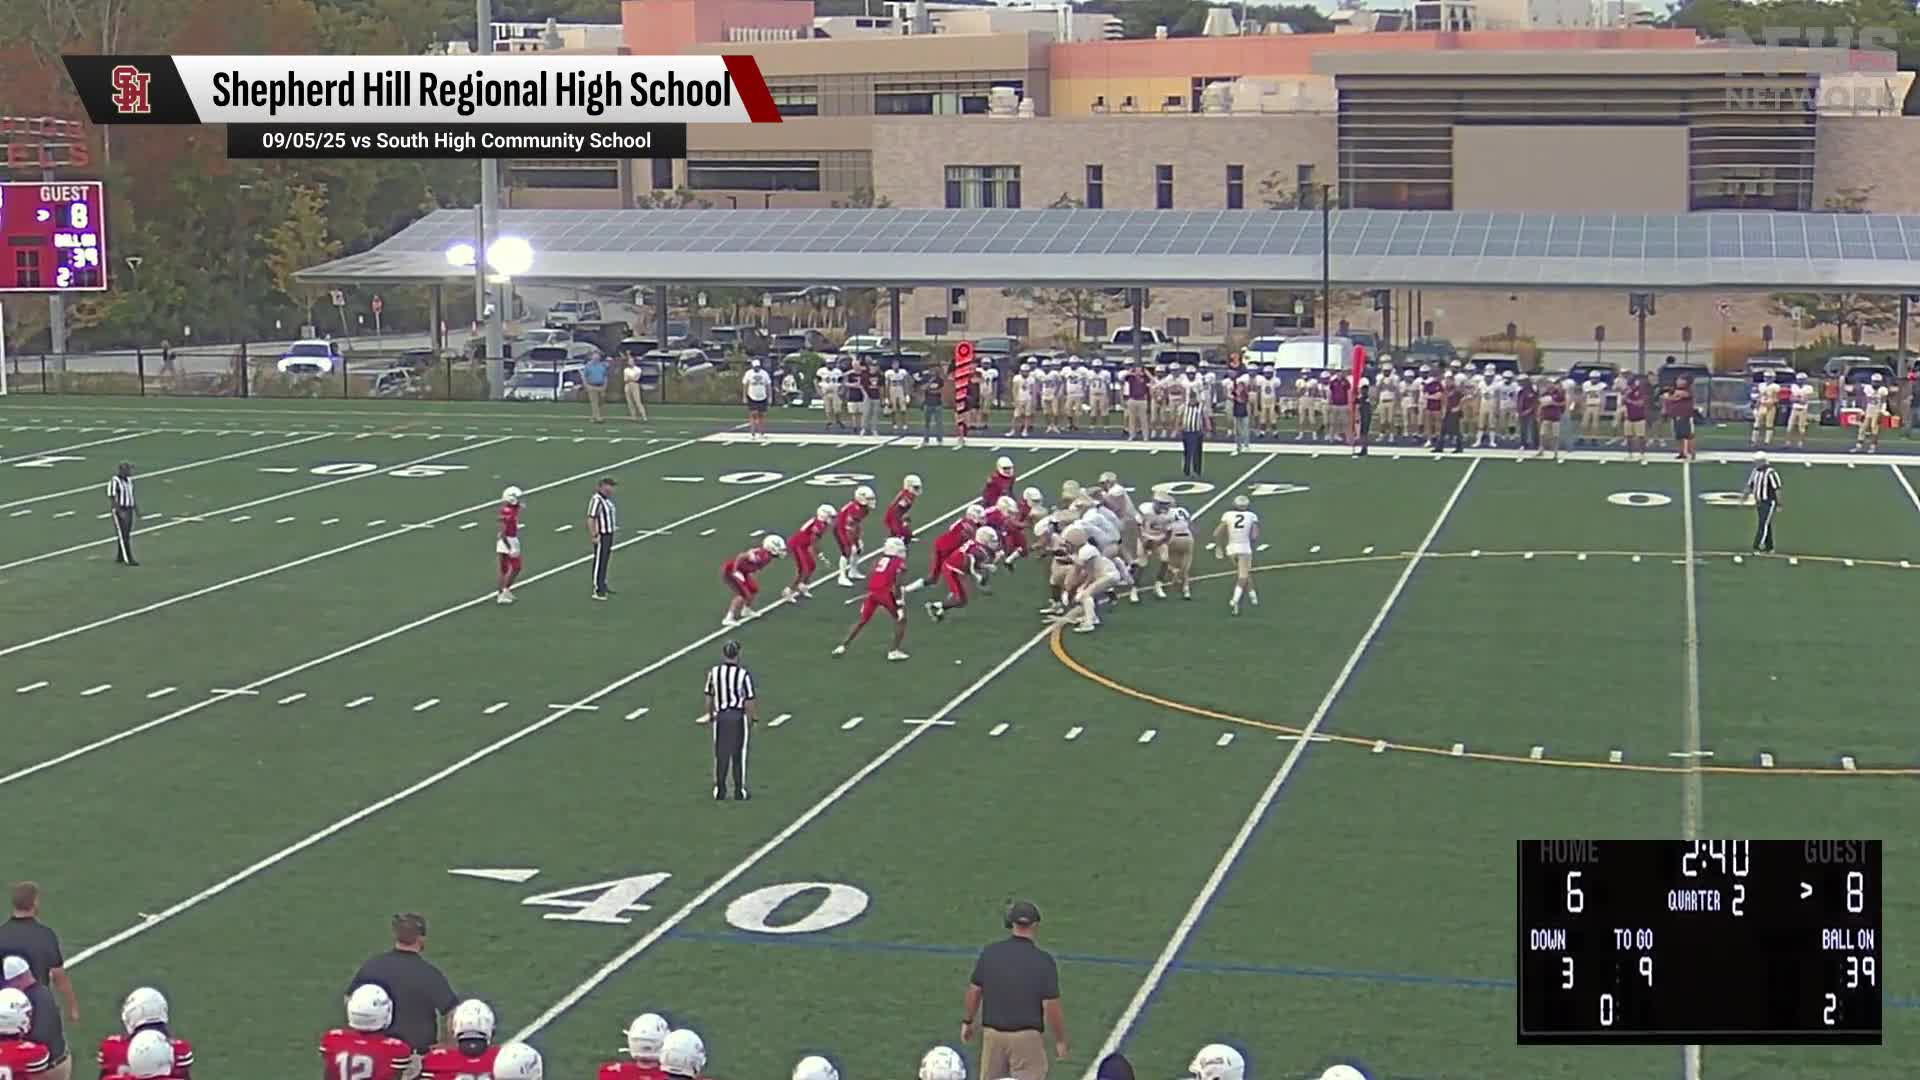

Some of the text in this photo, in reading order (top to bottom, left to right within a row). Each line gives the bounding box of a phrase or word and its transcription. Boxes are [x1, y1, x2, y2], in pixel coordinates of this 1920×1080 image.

[40, 186, 89, 201] GUEST
[70, 203, 88, 228] 8
[1234, 513, 1246, 529] 2
[875, 556, 891, 573] 9
[335, 1051, 374, 1080] 12
